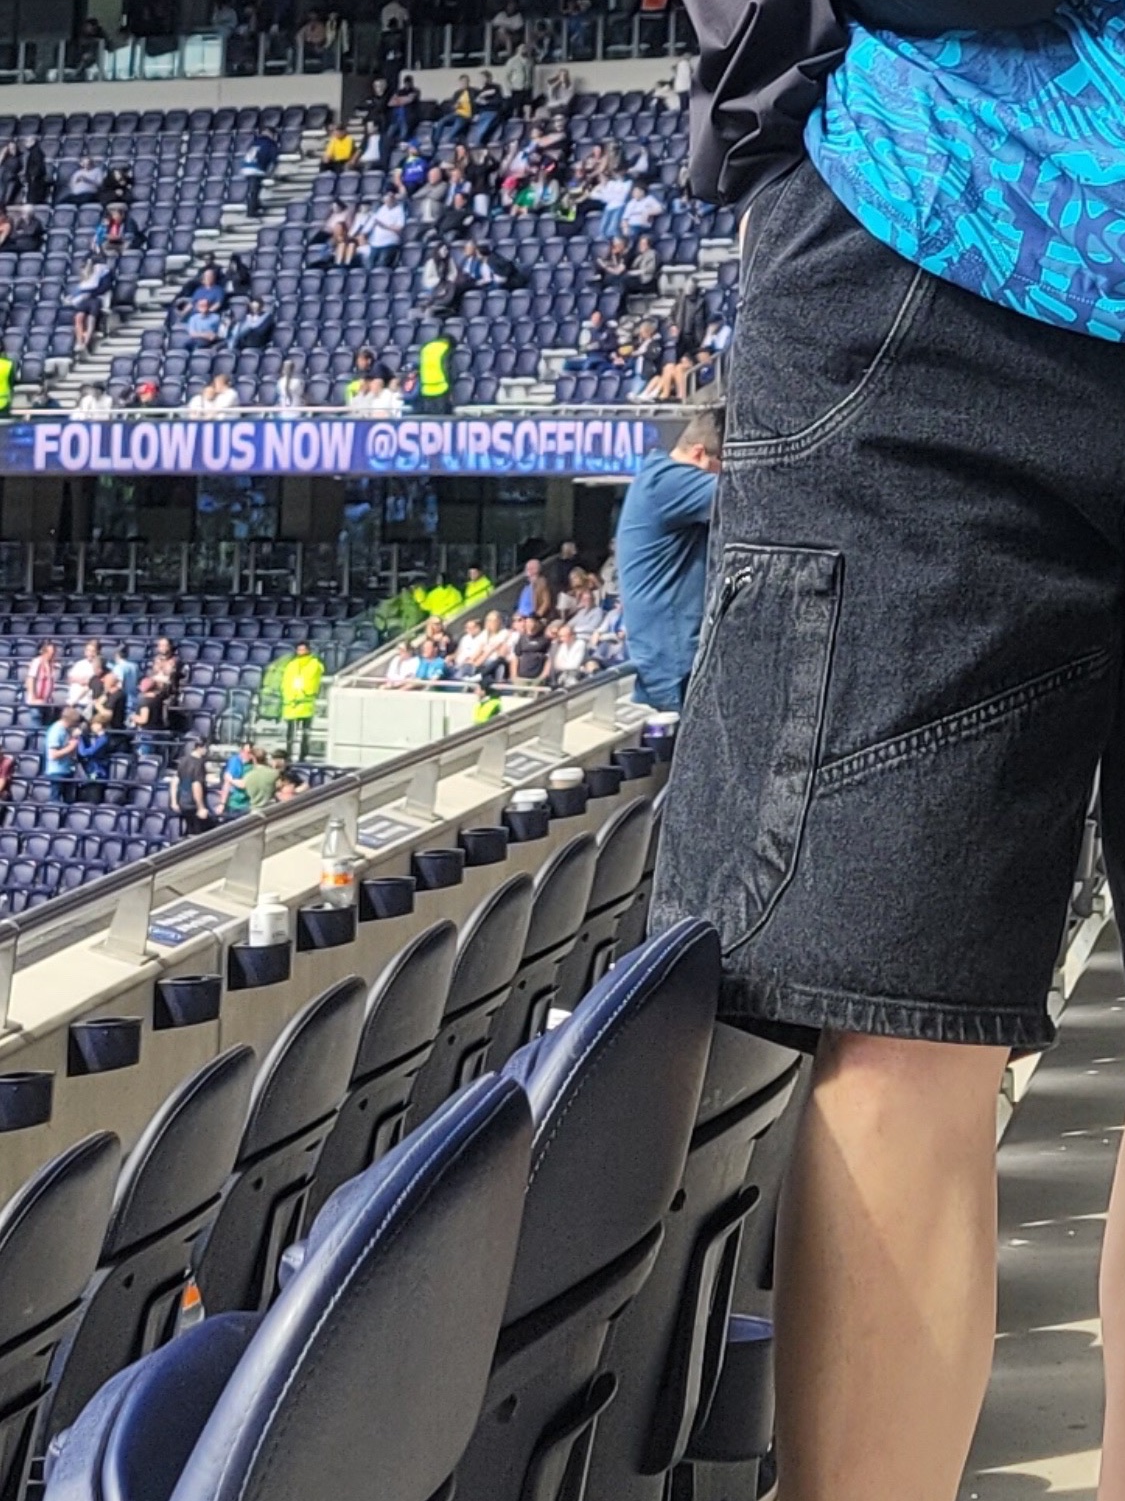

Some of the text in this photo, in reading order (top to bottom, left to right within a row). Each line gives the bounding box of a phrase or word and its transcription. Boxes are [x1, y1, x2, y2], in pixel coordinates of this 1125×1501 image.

[33, 421, 199, 472] FOLLOW
[202, 421, 257, 472] US
[262, 421, 355, 471] NOW
